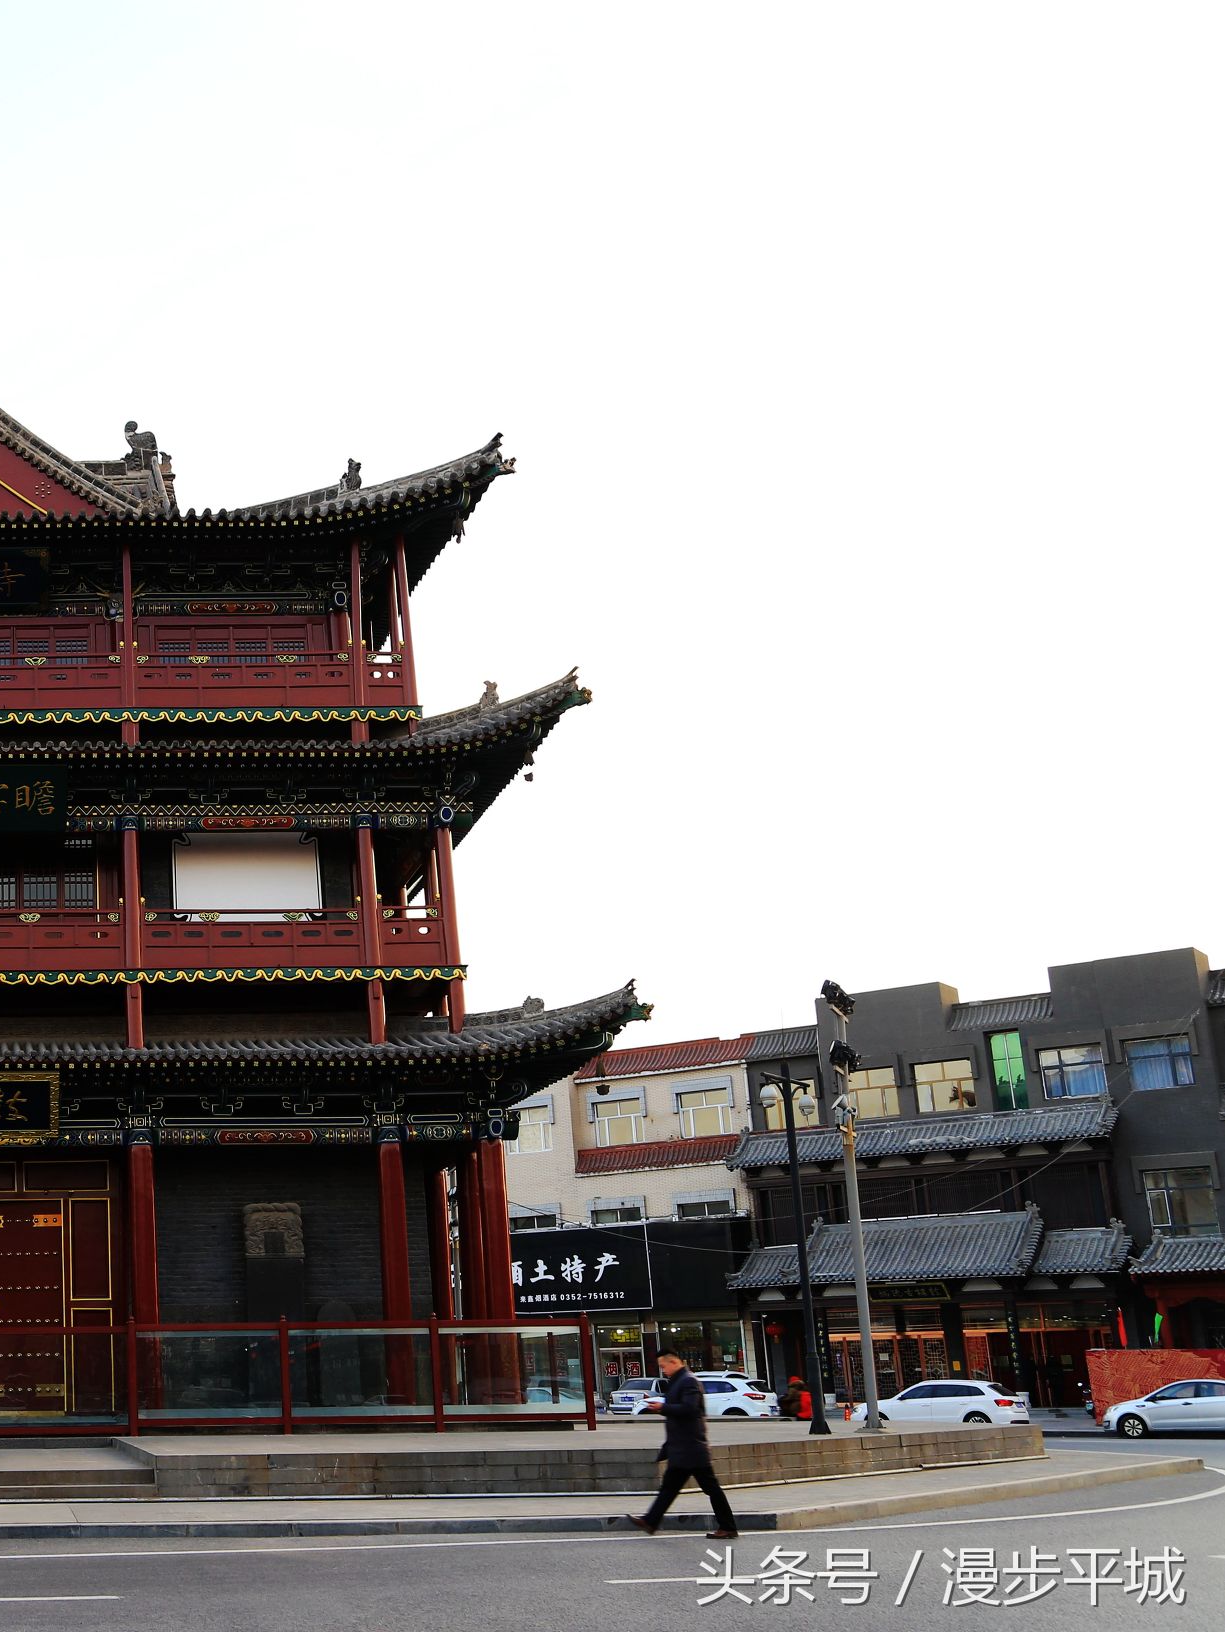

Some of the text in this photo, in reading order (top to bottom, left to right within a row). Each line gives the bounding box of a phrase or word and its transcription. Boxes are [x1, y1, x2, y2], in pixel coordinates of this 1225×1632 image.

[560, 1291, 625, 1301] 0352-7516312
[606, 1362, 640, 1377] 烟 酒
